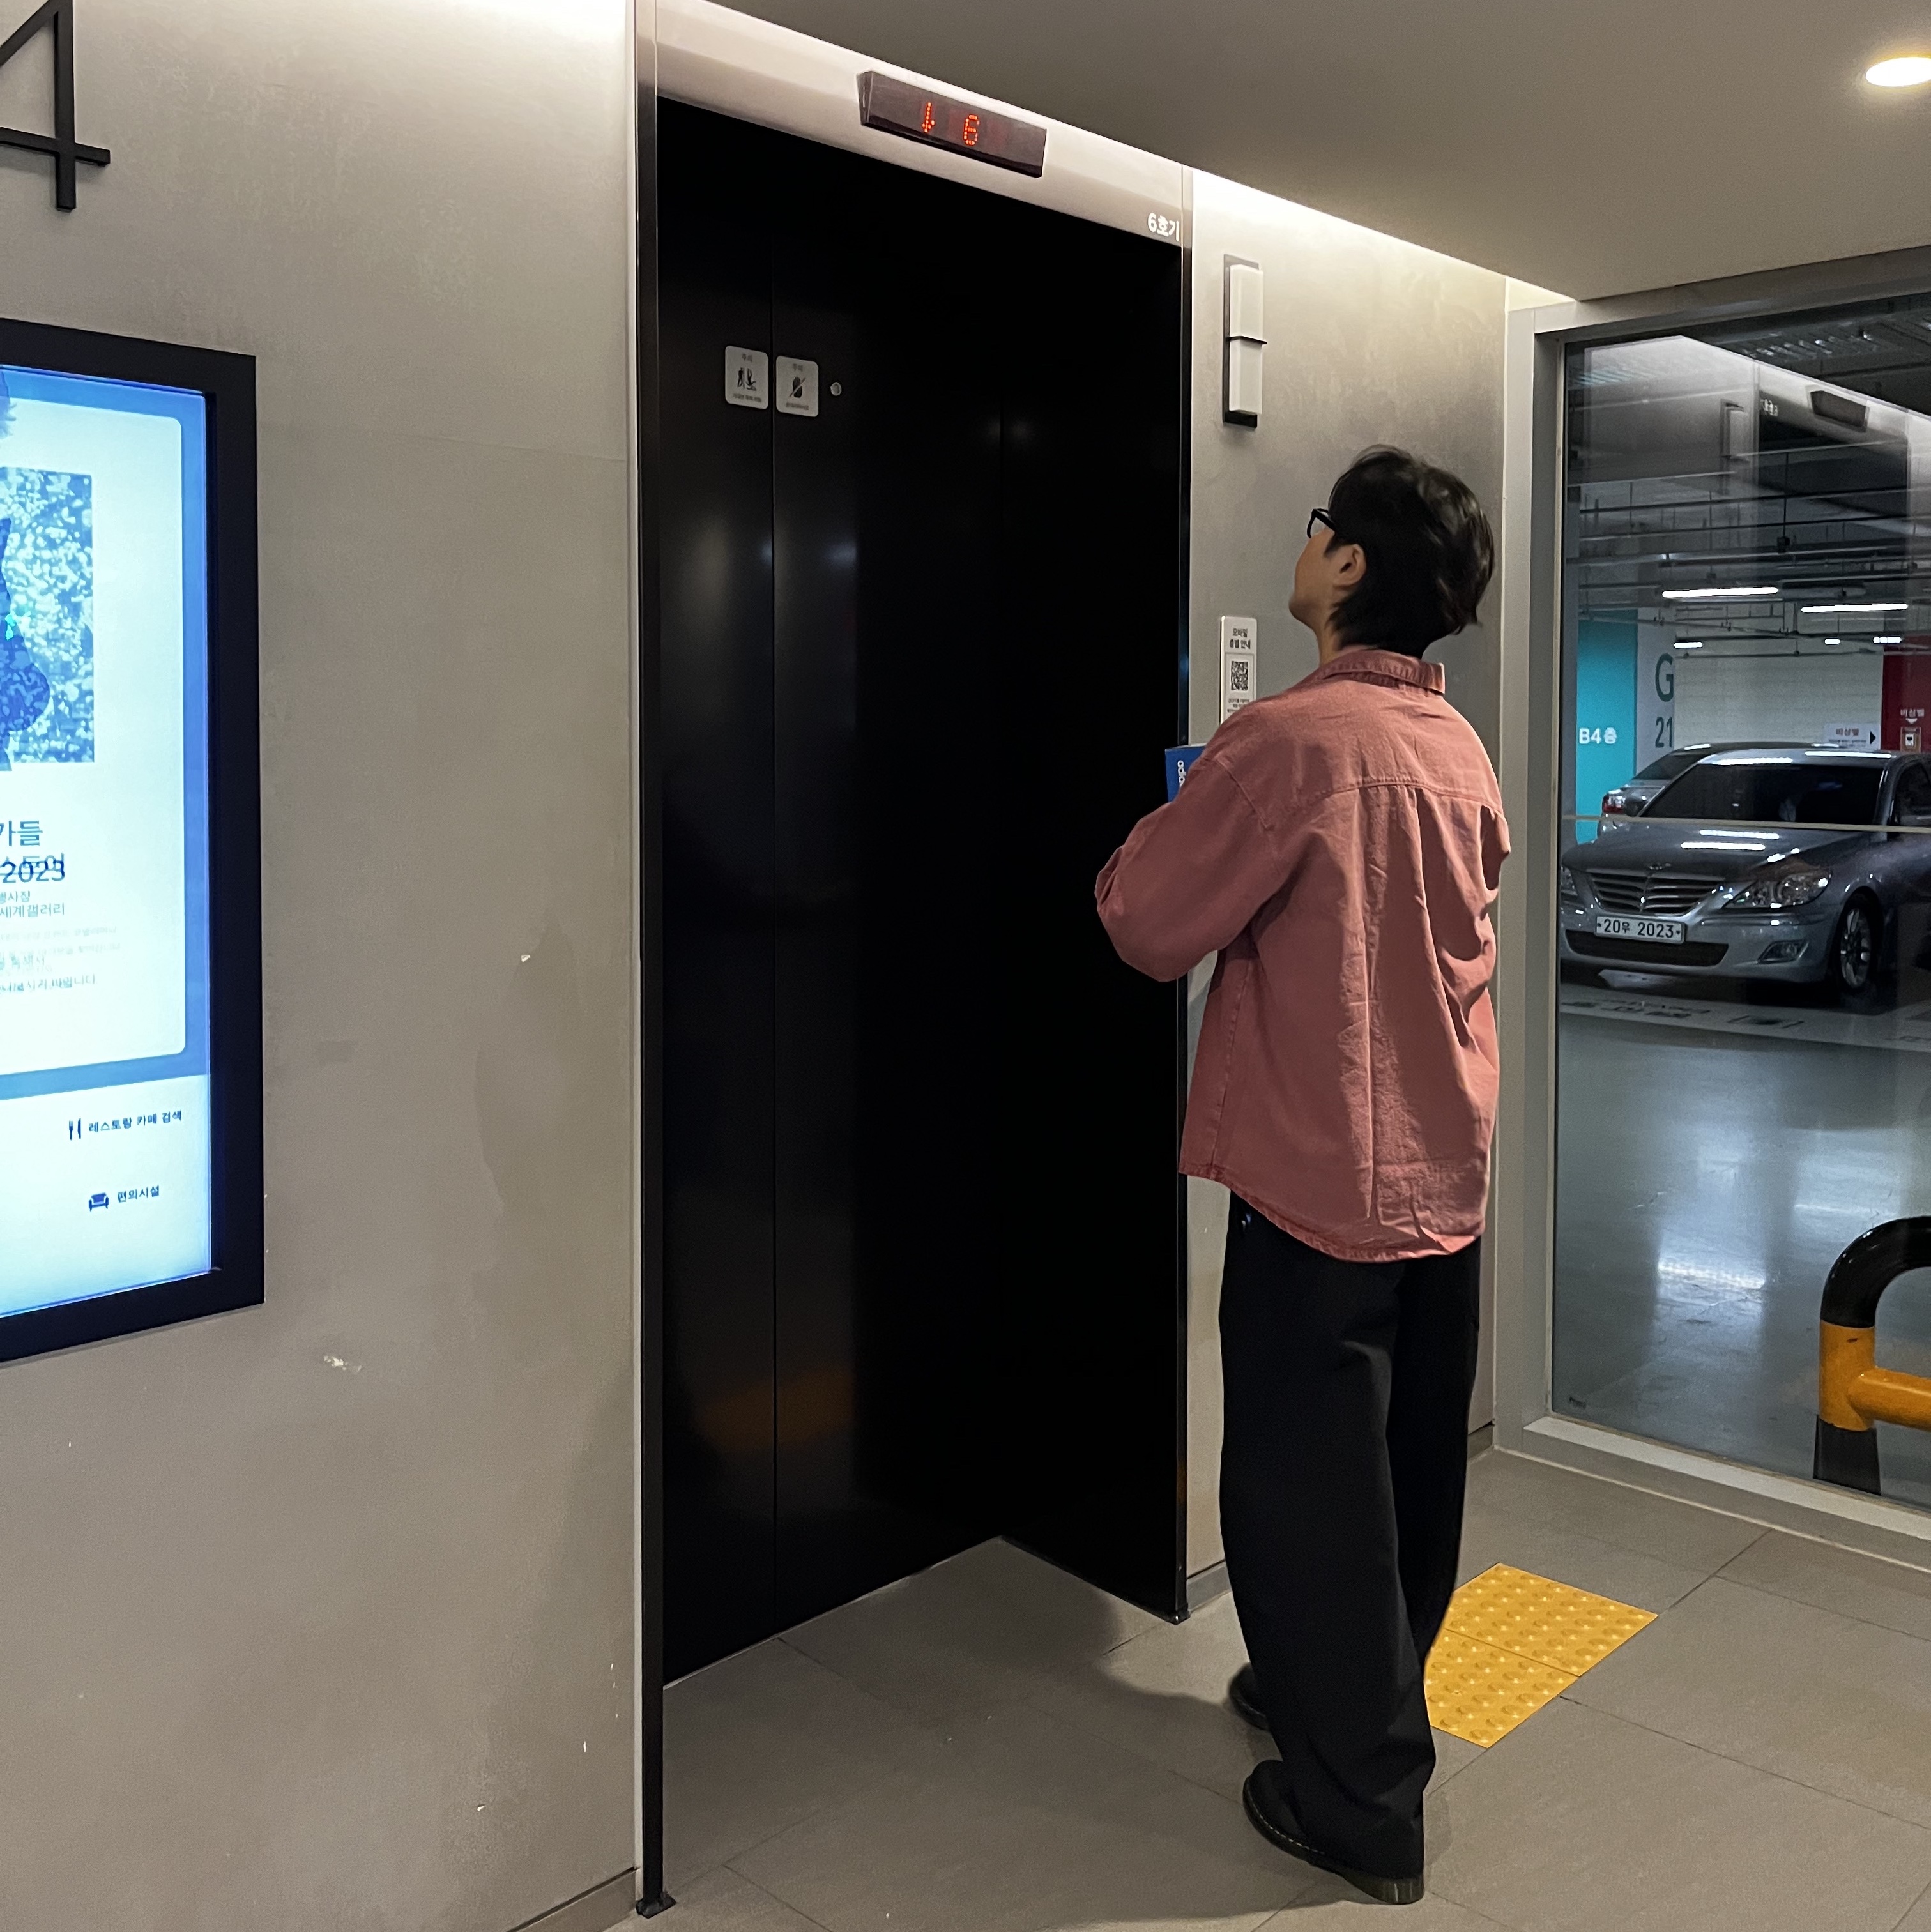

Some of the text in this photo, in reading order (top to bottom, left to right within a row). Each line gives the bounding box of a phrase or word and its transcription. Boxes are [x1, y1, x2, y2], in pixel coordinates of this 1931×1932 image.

[963, 114, 980, 146] 6
[1148, 213, 1180, 241] 6호기
[1655, 653, 1674, 703] G
[1655, 716, 1673, 749] 21
[1604, 918, 1674, 938] 20우 2023
[89, 1117, 132, 1132] 레스토랑
[162, 1110, 182, 1123] 검색
[118, 1185, 159, 1203] 편의시설
